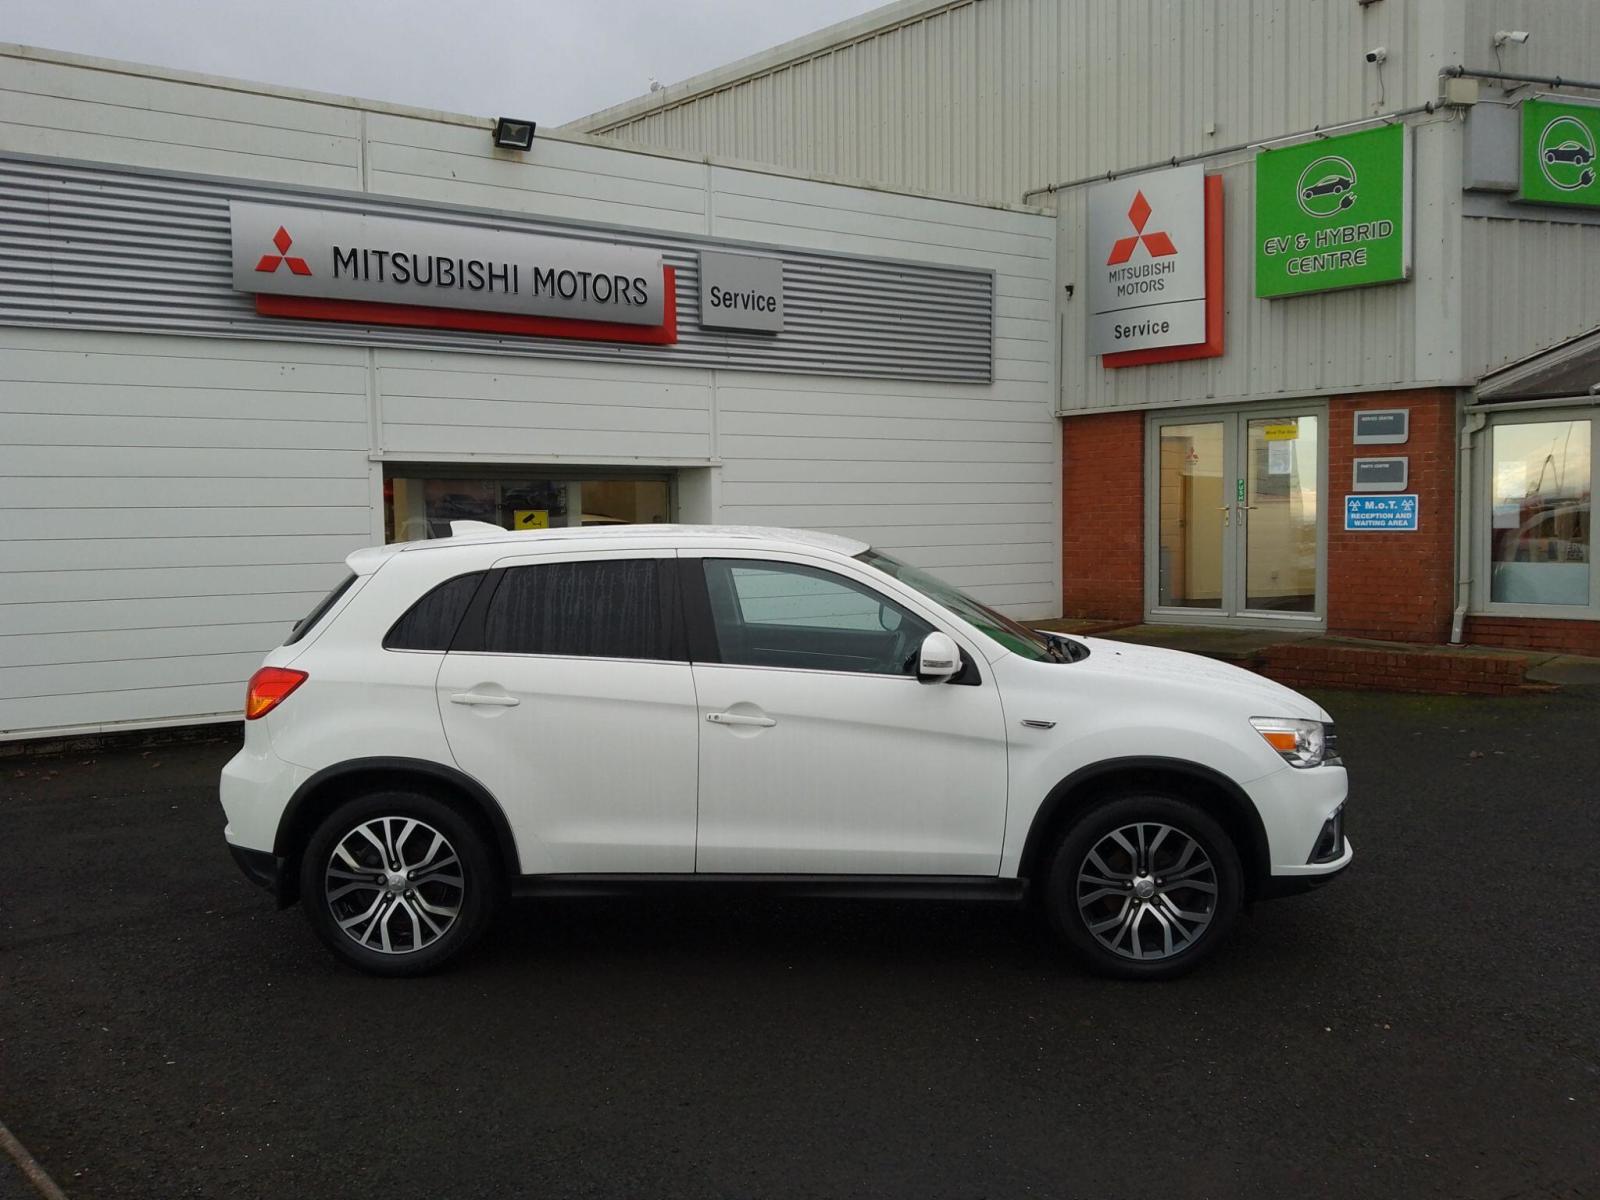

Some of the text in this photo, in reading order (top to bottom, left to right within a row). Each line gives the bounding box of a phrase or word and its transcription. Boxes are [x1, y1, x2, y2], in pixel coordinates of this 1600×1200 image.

[1264, 220, 1394, 255] EV & HYBRID
[1108, 260, 1175, 283] MITSUBISHI
[1287, 248, 1367, 275] CENTRE
[332, 245, 648, 306] MITSUBISHI MOTORS
[1117, 278, 1165, 297] MOTORS
[710, 286, 777, 313] Service
[1114, 320, 1170, 340] Service
[1365, 501, 1398, 509] M.o.T.
